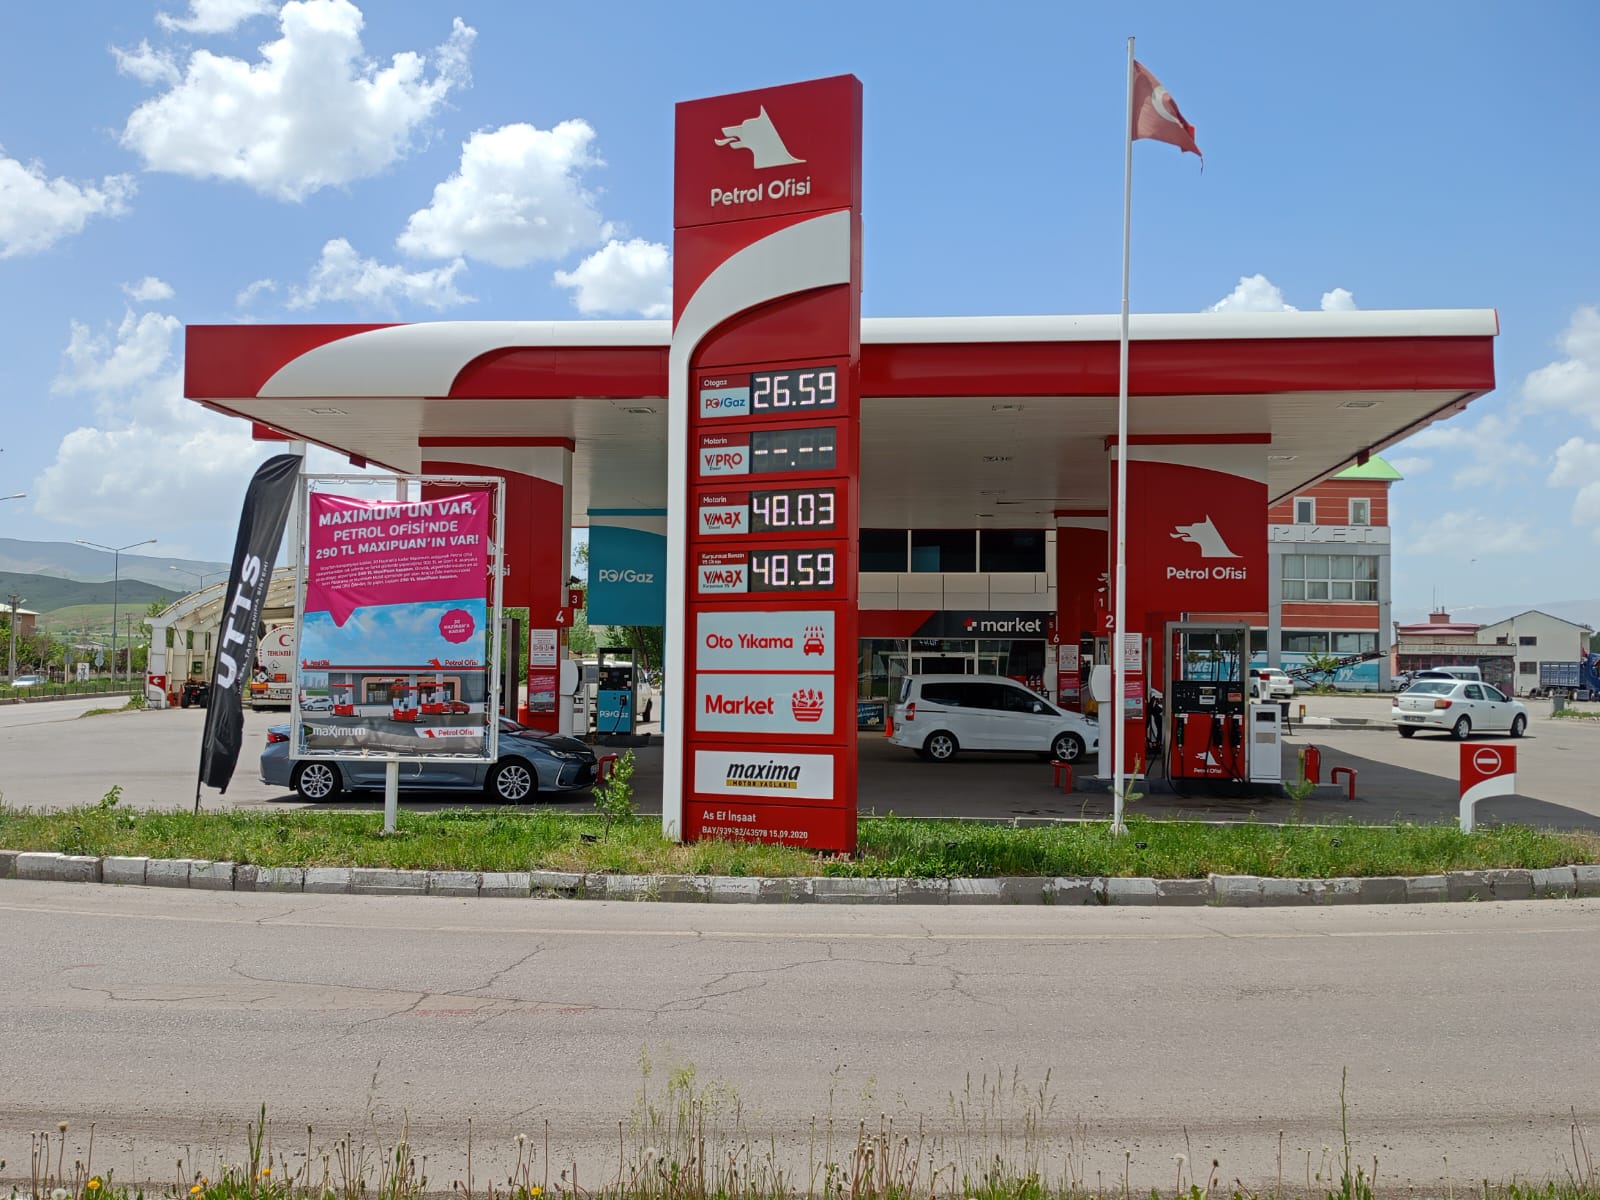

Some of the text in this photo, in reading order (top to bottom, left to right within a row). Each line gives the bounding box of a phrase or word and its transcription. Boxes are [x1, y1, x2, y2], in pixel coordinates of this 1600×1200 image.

[710, 176, 811, 207] Petrol Ofisi
[703, 379, 728, 388] Otogaz
[754, 372, 836, 408] 26.59
[703, 437, 728, 445] Motorin
[703, 496, 727, 504] Motorin
[438, 501, 477, 516] VAR,
[753, 493, 834, 526] 48.03
[333, 520, 458, 542] PETROL OFİSİ'NDE
[315, 535, 479, 560] 290 TL MAXIPUAN'IN VAR!
[752, 553, 834, 586] 48.59
[1166, 566, 1247, 580] Petrol Ofisi
[571, 595, 578, 604] 3
[1098, 598, 1104, 607] 1
[217, 553, 261, 689] UTTS
[556, 610, 565, 623] 4
[1105, 615, 1115, 628] 2
[980, 617, 1042, 633] market
[705, 633, 794, 649] Oto Yıkama
[1053, 634, 1060, 643] 6
[444, 659, 464, 667] Petrol
[705, 694, 775, 715] Market
[438, 728, 475, 737] Petrol Ofisi
[727, 760, 801, 780] maxima
[703, 809, 757, 823] As Ef İnşaat
[769, 829, 808, 839] 15.09.2020
